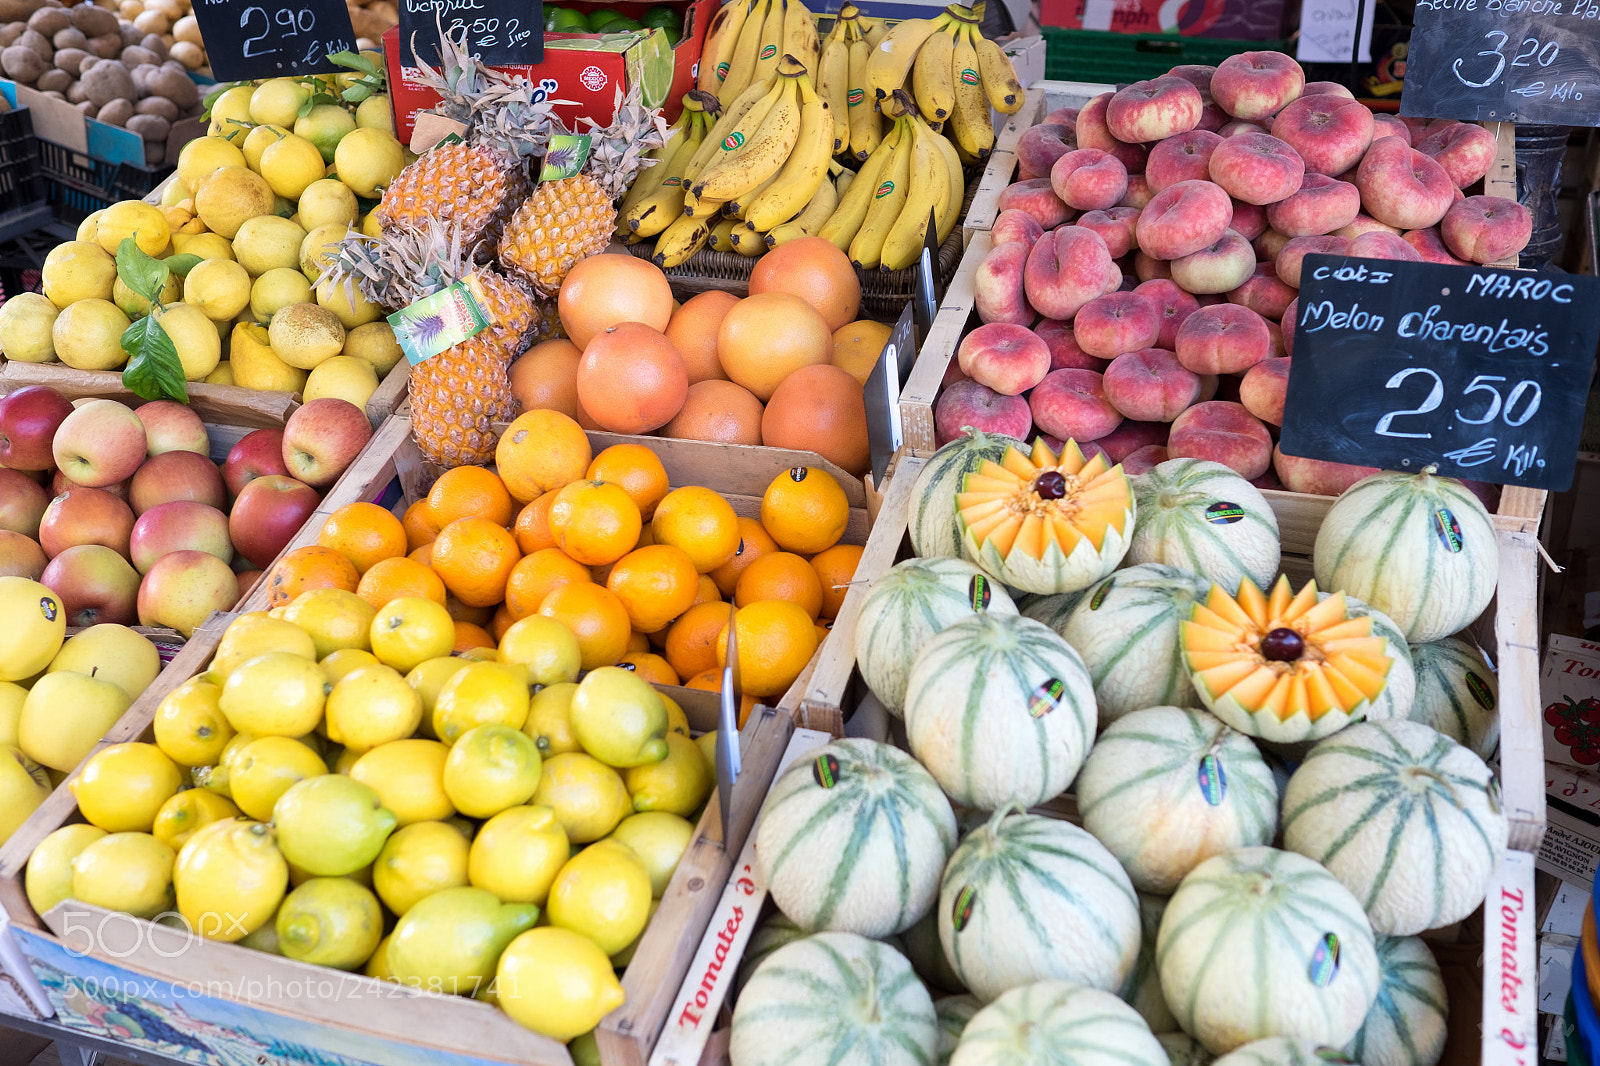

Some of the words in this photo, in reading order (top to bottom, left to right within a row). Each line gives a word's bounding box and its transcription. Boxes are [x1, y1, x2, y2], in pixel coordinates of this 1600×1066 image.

[1465, 273, 1575, 303] MAROC
[1300, 300, 1384, 333] Melon
[1397, 304, 1550, 357] Charentais
[1554, 845, 1591, 865] AVIGNON
[678, 905, 744, 1030] Tomates
[1500, 885, 1524, 1015] Tomates
